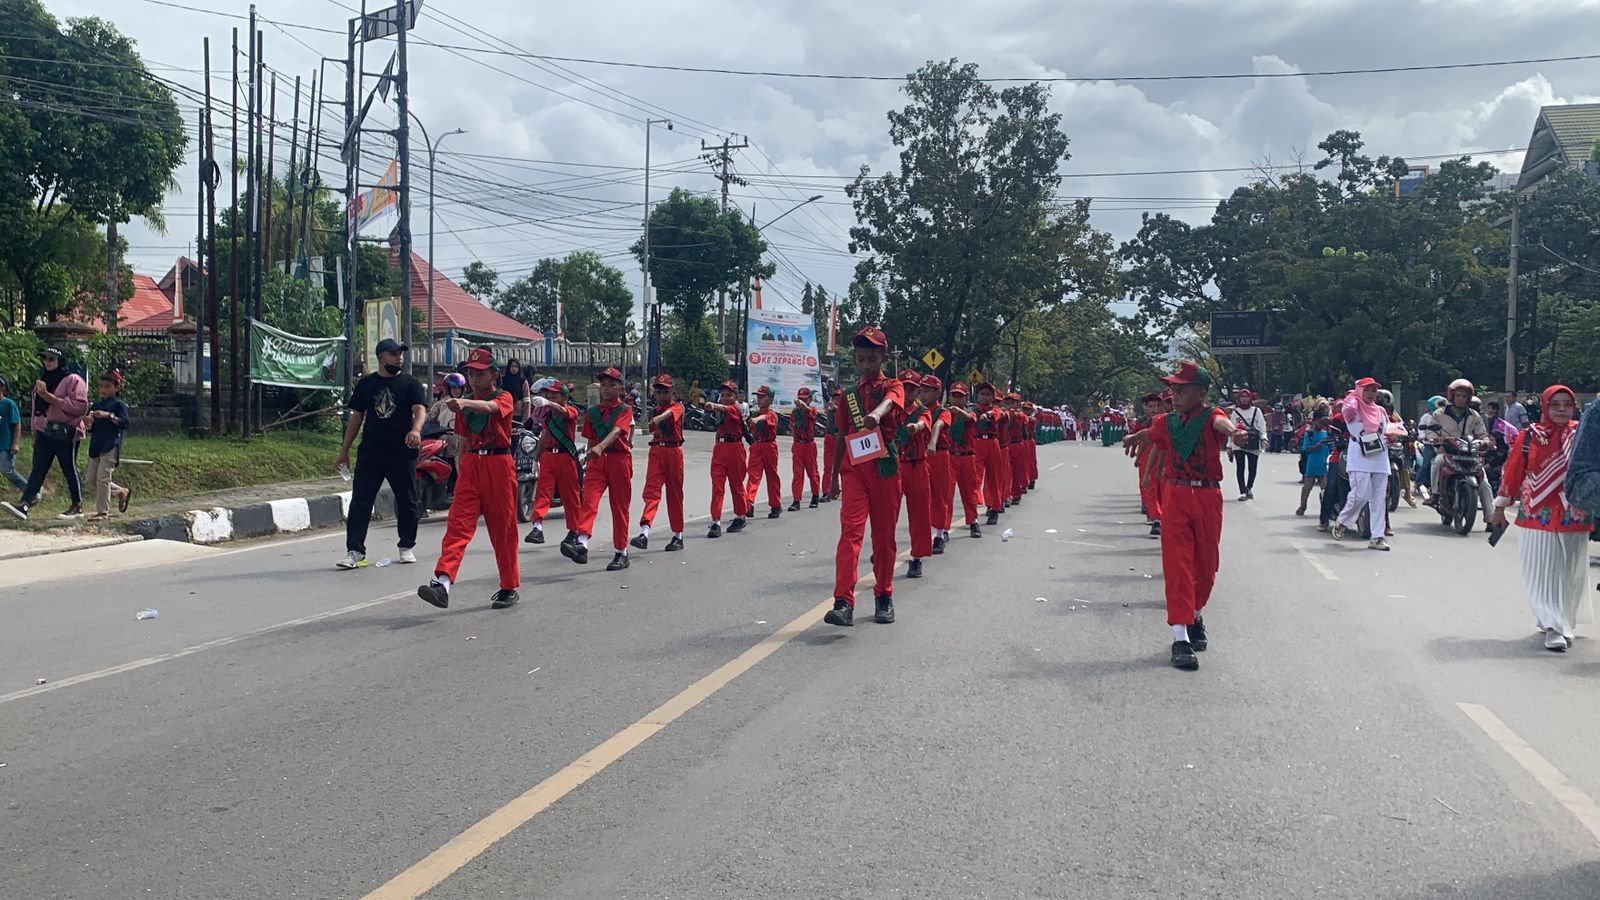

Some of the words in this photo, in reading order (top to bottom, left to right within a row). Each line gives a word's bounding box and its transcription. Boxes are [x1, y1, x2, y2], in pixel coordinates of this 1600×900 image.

[1216, 338, 1234, 346] FINE
[297, 355, 316, 365] KITA
[761, 356, 771, 364] KE
[847, 392, 860, 415] SDN
[859, 437, 871, 450] 10
